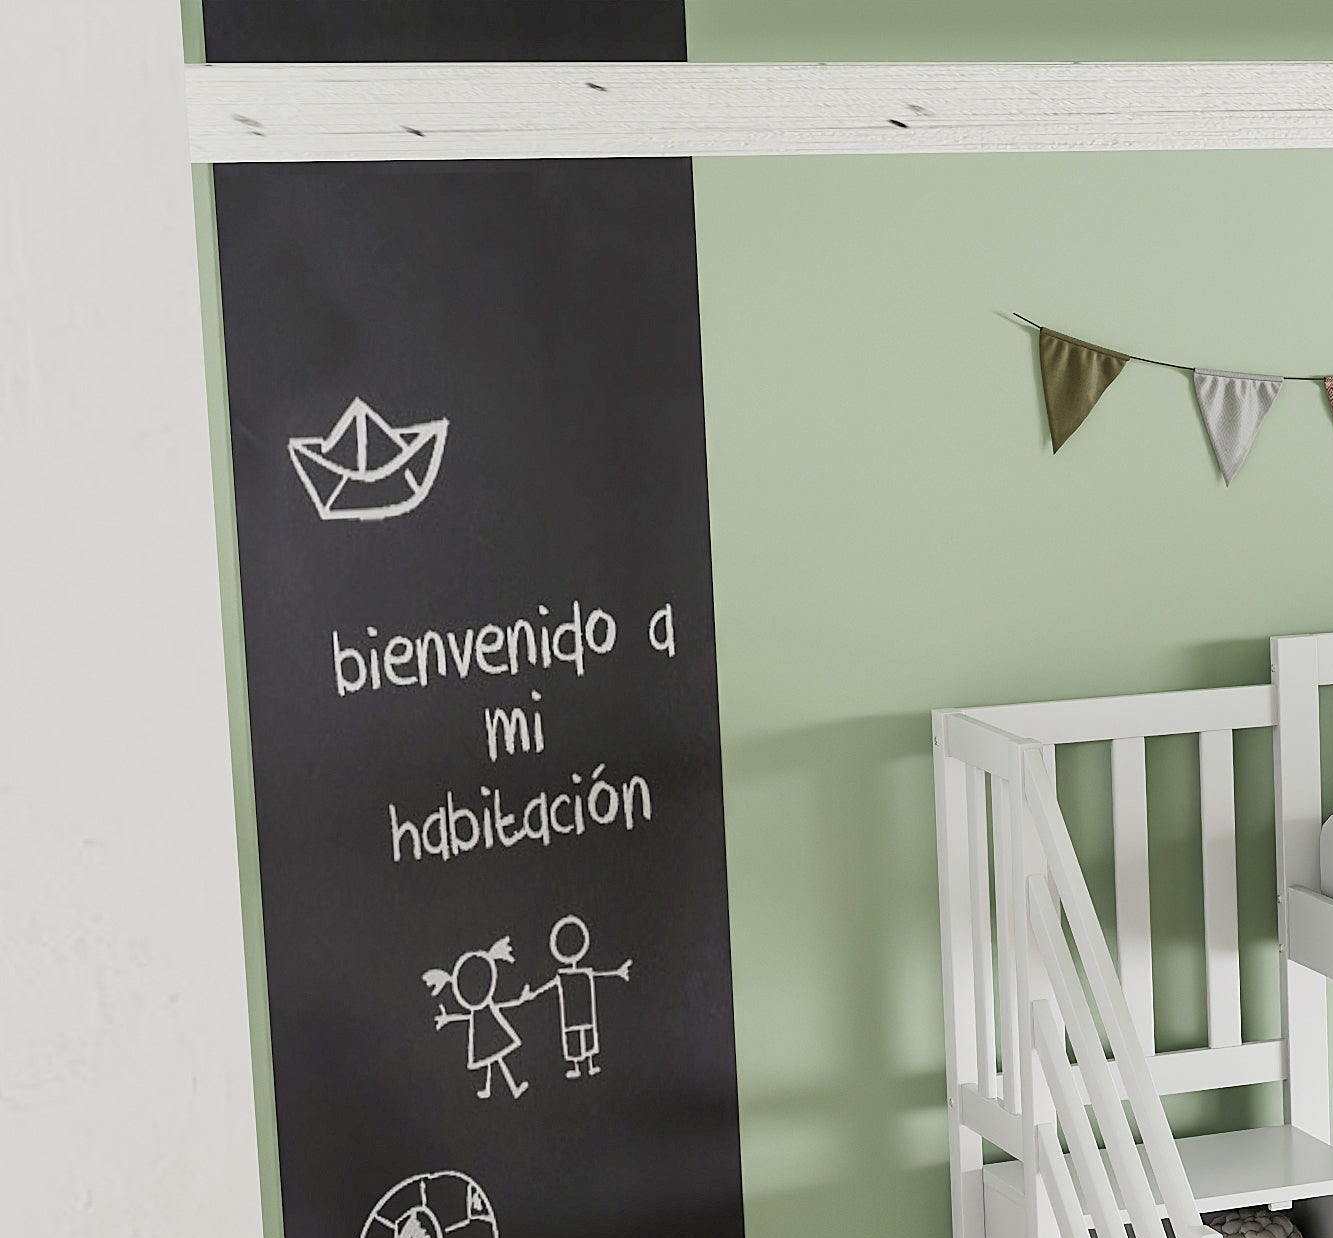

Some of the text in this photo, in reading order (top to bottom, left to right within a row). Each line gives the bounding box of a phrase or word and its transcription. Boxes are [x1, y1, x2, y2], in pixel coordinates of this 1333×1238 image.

[332, 600, 676, 698] bienvenido a
[484, 689, 545, 763] mi
[388, 763, 652, 862] habitación
